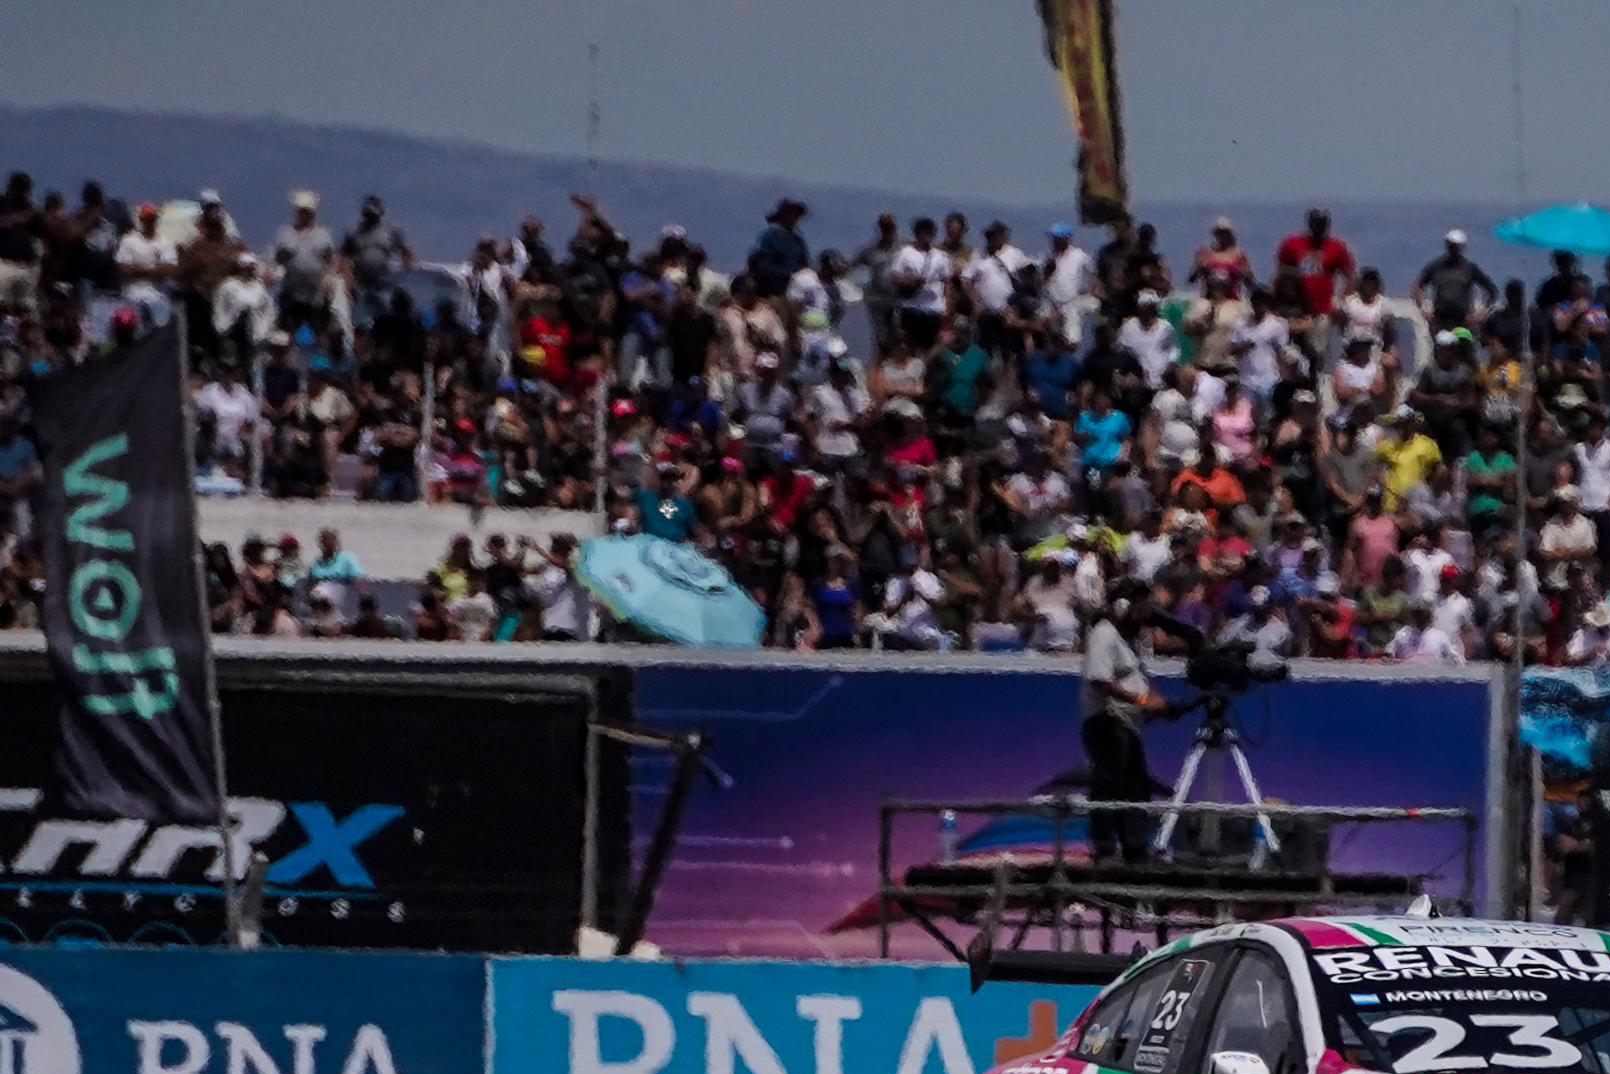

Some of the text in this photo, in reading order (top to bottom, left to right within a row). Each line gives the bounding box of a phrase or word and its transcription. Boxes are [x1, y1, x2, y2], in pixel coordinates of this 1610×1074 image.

[1152, 989, 1191, 1031] 23
[1386, 990, 1548, 1003] MONTENEGRO
[1368, 1013, 1583, 1074] 23
